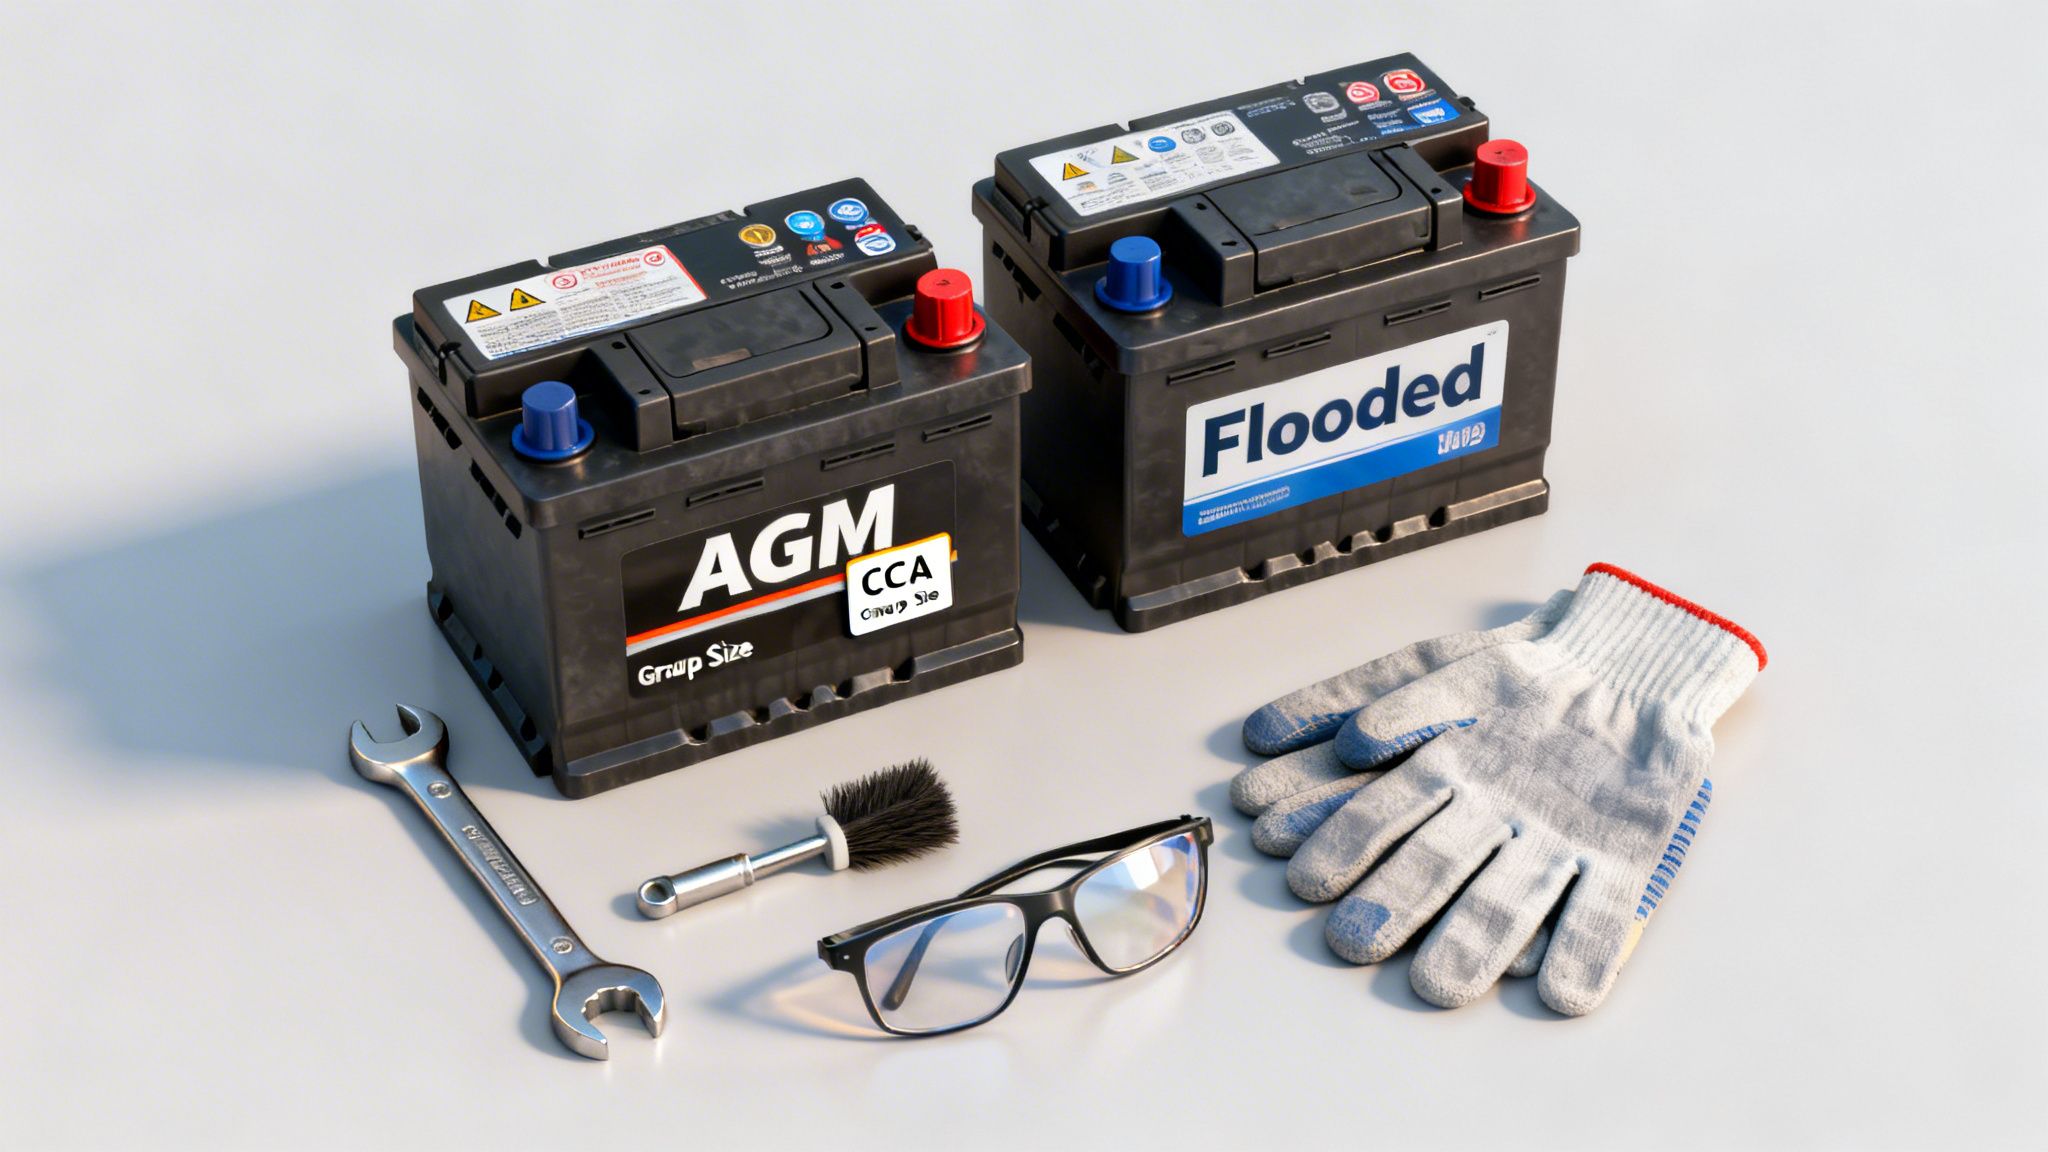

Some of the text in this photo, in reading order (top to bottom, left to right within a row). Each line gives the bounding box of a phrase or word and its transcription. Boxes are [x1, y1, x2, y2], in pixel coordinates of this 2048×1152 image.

[1202, 342, 1486, 478] Flooded
[677, 484, 895, 612] AGM
[862, 554, 932, 596] CCA
[706, 640, 754, 668] Size
